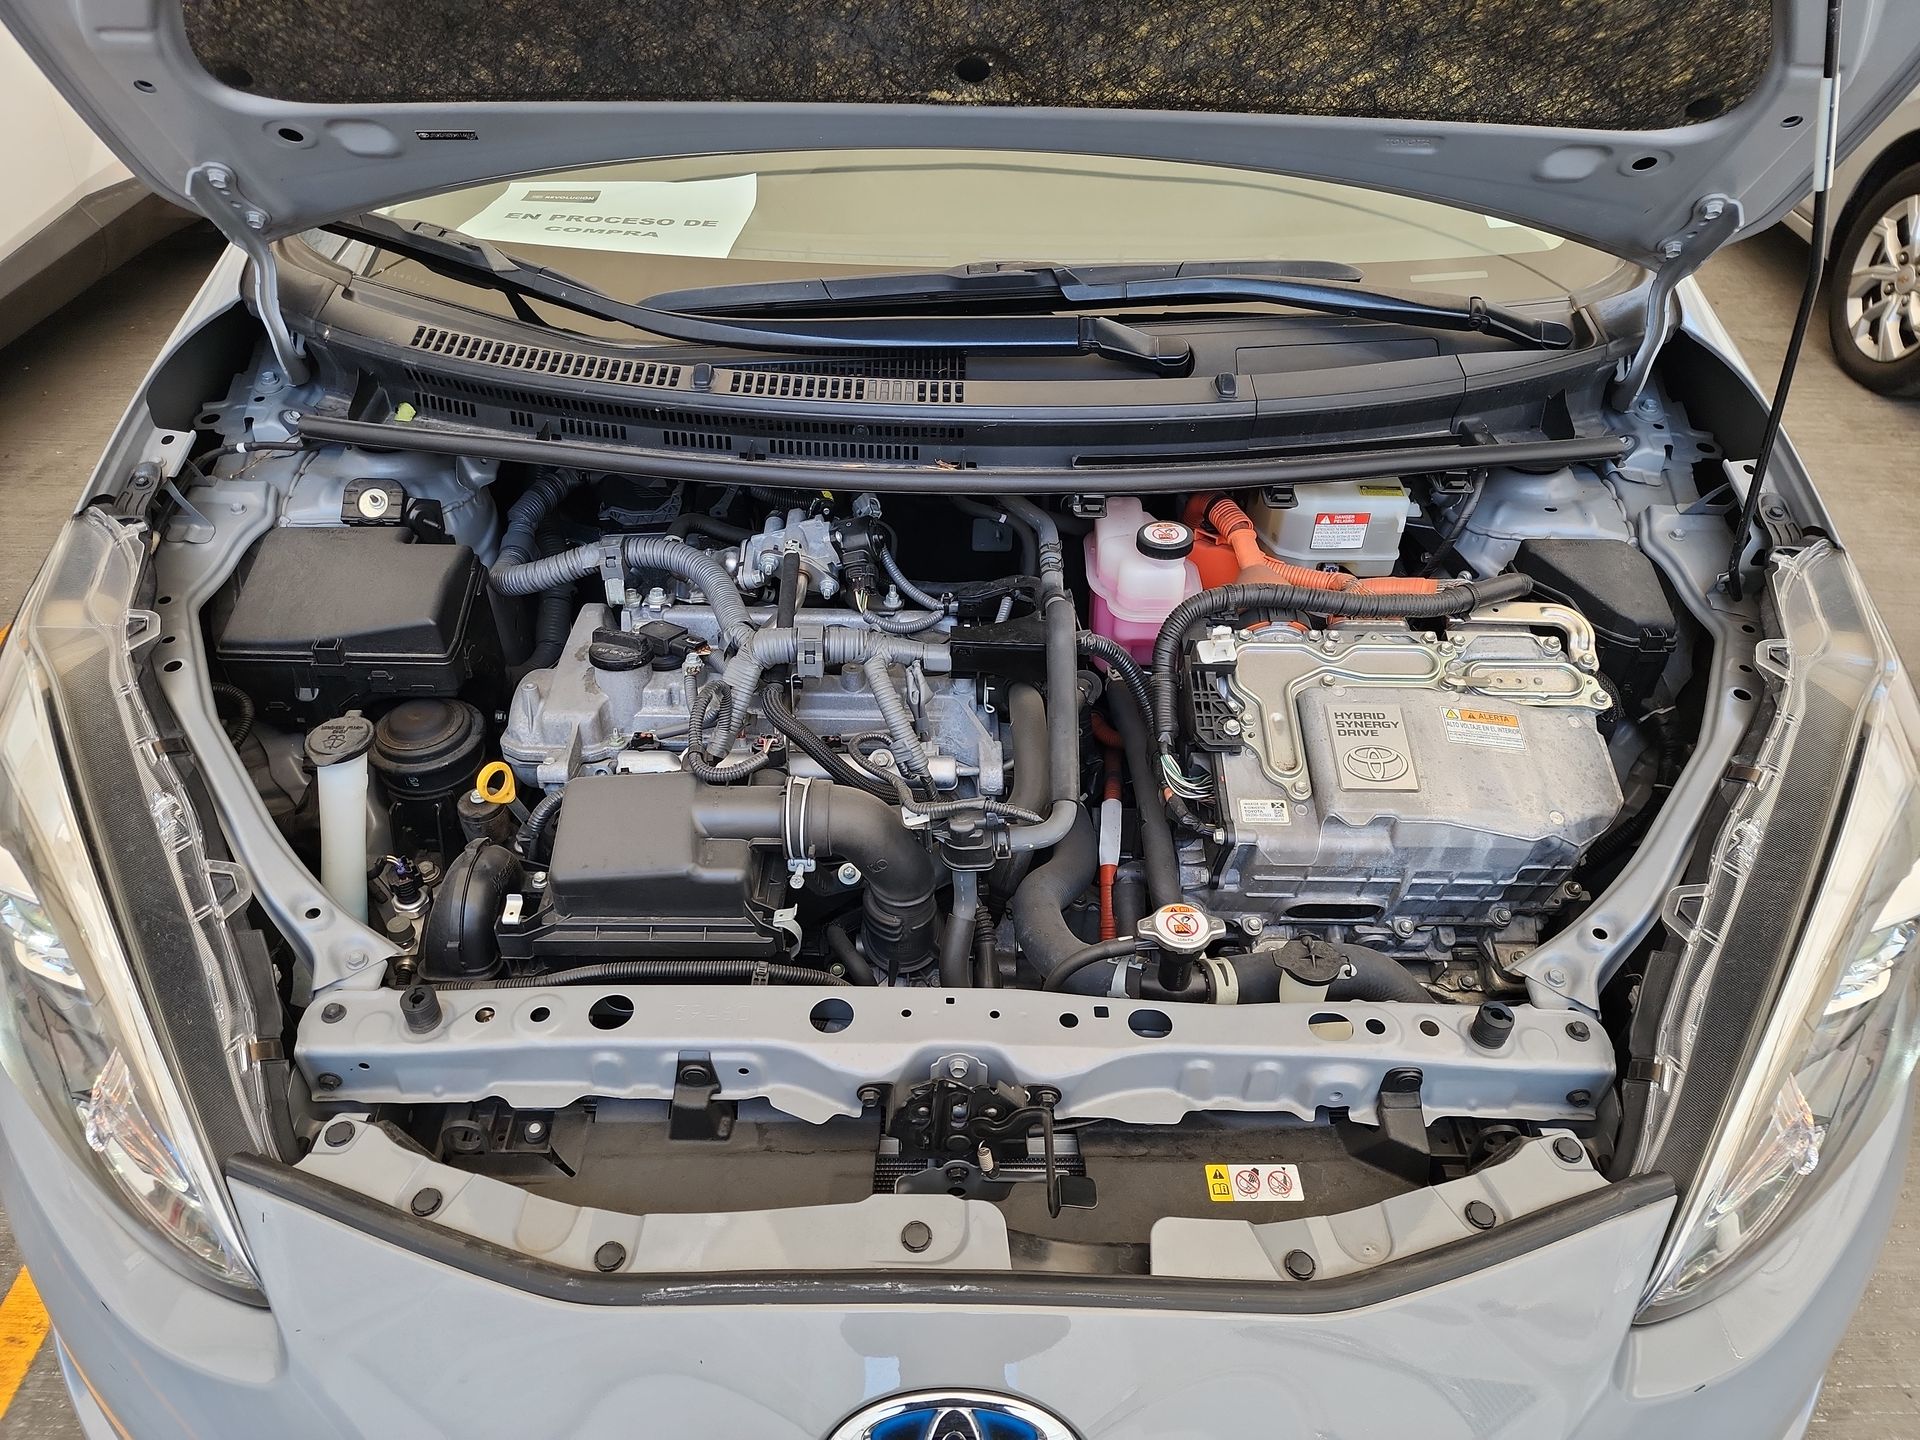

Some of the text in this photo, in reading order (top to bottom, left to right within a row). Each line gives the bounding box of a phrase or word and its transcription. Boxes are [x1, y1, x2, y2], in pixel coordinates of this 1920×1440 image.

[549, 214, 675, 226] PROCESO
[683, 219, 719, 227] DE
[544, 226, 659, 238] COMPRA
[1334, 712, 1386, 720] HYBRID
[1478, 713, 1510, 722] ALERTA
[1335, 720, 1399, 729] SYNERGY
[1460, 723, 1483, 731] VOLTAJE
[1497, 727, 1521, 735] INTERIOR
[1337, 729, 1380, 737] DRIVE
